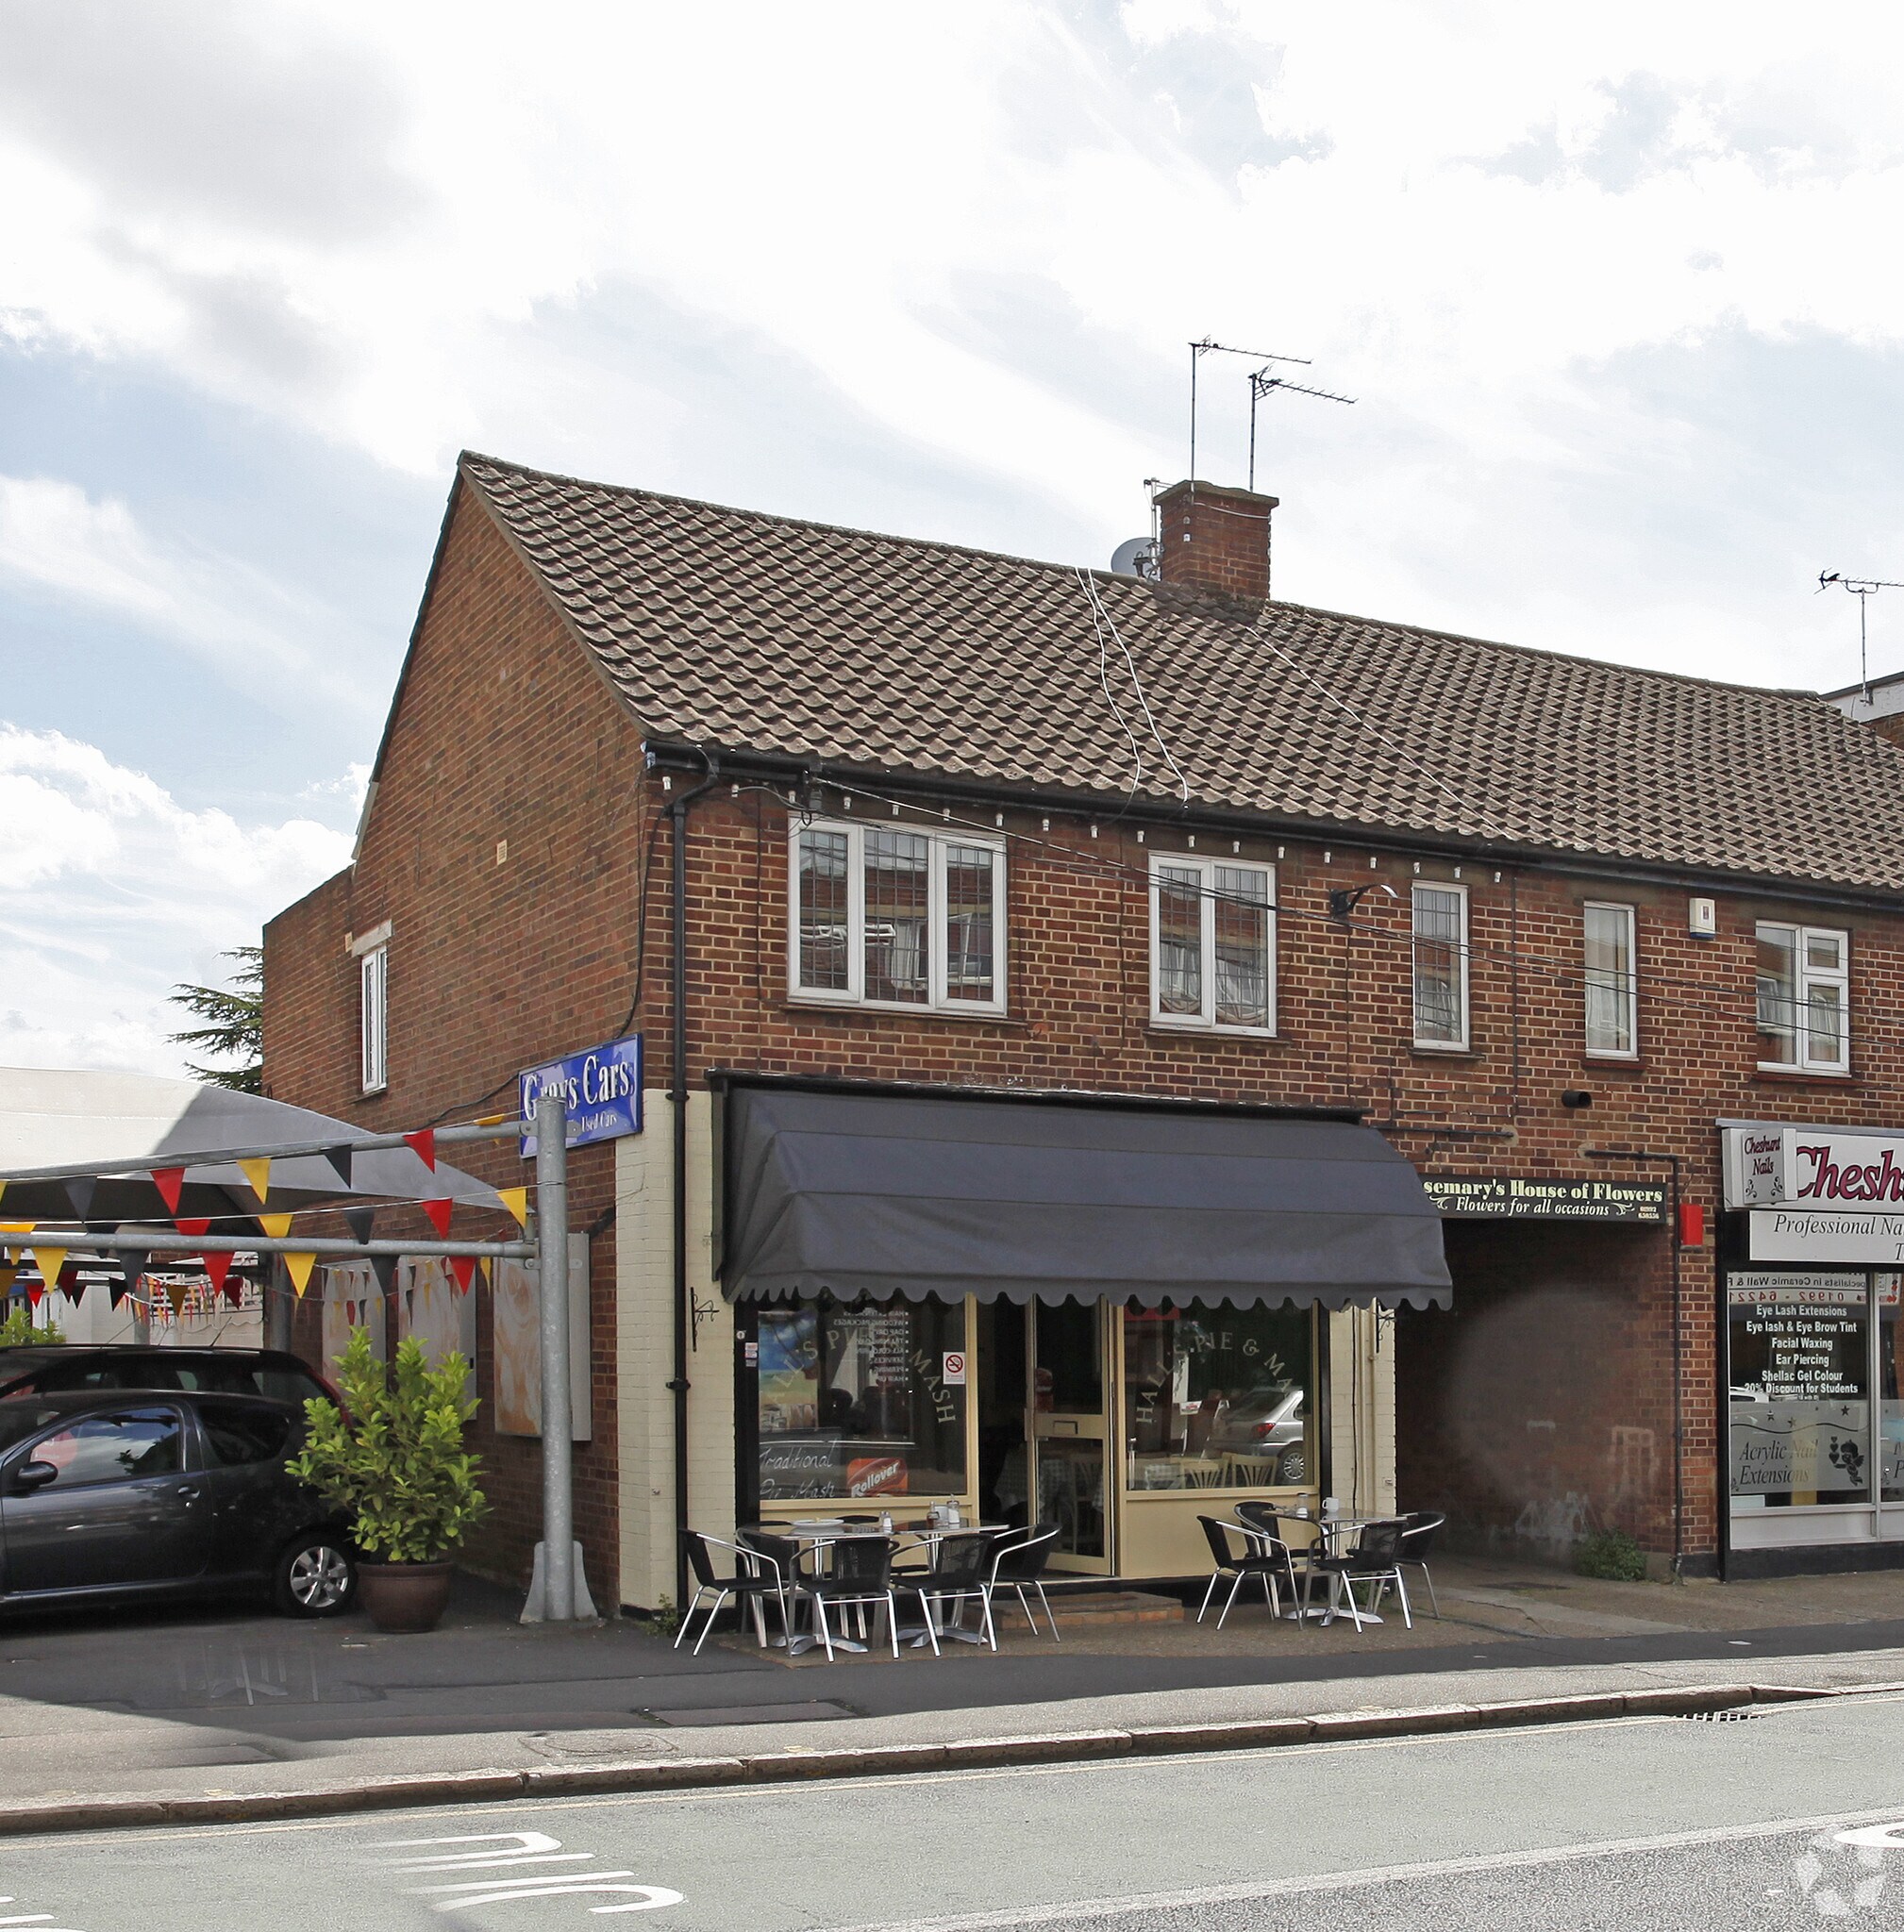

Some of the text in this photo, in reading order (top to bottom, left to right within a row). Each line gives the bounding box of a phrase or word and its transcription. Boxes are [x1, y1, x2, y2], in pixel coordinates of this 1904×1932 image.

[582, 1055, 630, 1105] Cars
[1744, 1135, 1780, 1156] Cheshunt
[1752, 1157, 1774, 1175] Nails
[1796, 1146, 1904, 1203] Chesh
[1423, 1178, 1662, 1202] semary's House of Flowers
[1456, 1196, 1610, 1216] Flowers for all occasions
[1774, 1214, 1904, 1238] Professional Na
[1756, 1303, 1847, 1318] Eye Lash Extensions
[1746, 1321, 1857, 1335] Eye lash & Eye Brow Tint
[1194, 1332, 1233, 1353] PIE
[1243, 1339, 1260, 1357] &
[1772, 1338, 1833, 1350] Facial Waxing
[1776, 1354, 1829, 1367] Ear Piercing
[909, 1349, 957, 1424] MASH
[1762, 1370, 1843, 1382] Shellac Gel Colour
[1745, 1382, 1859, 1393] 20% Discount for Students
[759, 1438, 837, 1470] Traditional
[1739, 1440, 1787, 1465] Acrylic
[851, 1461, 900, 1498] Rollover
[1740, 1465, 1809, 1486] Extensions
